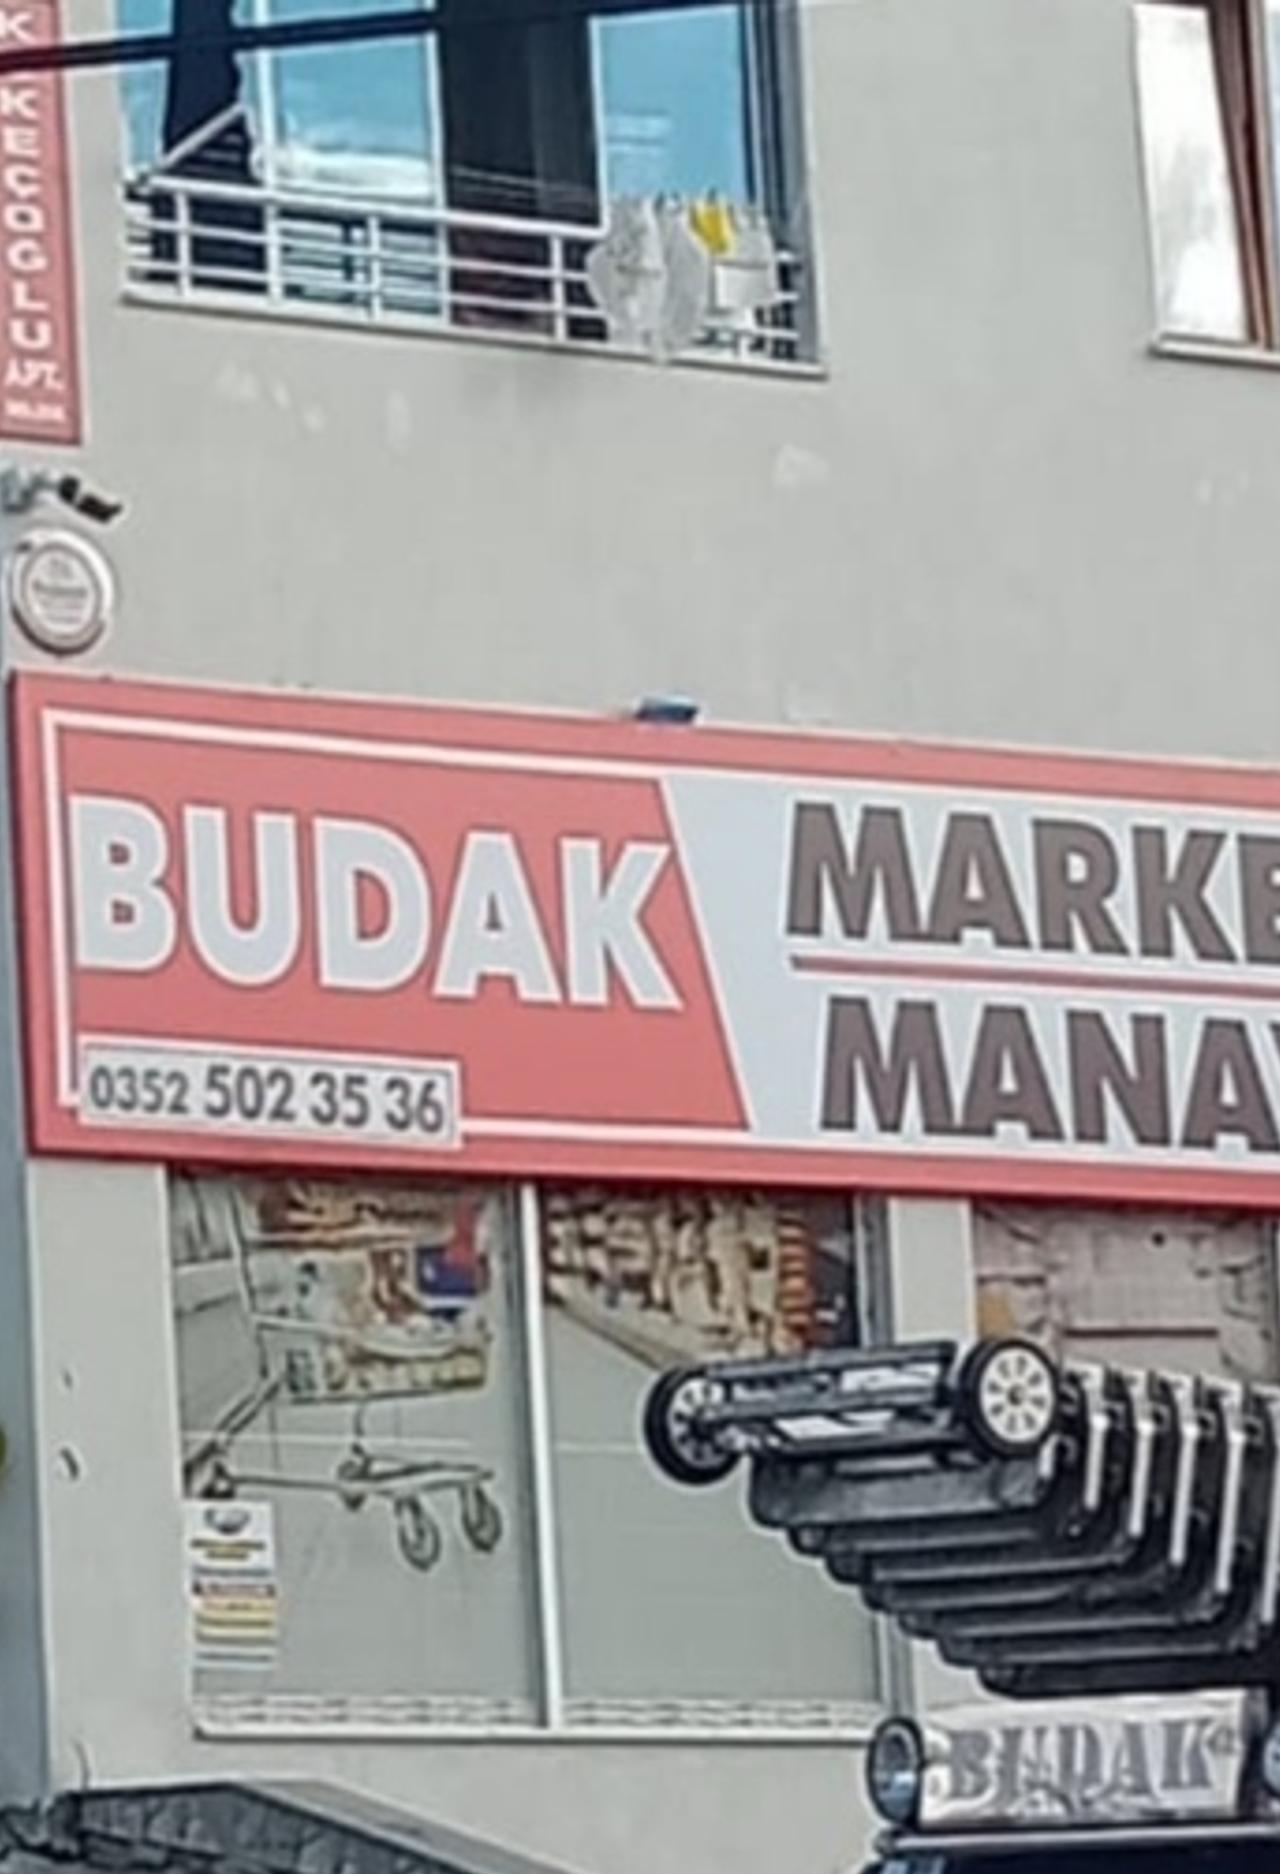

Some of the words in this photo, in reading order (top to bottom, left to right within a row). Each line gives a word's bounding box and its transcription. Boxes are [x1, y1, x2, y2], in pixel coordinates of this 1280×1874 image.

[66, 791, 686, 1013] BUDAK
[89, 1063, 190, 1115] 0352
[203, 1066, 295, 1123] 502
[310, 1072, 371, 1128] 35
[384, 1077, 445, 1134] 36
